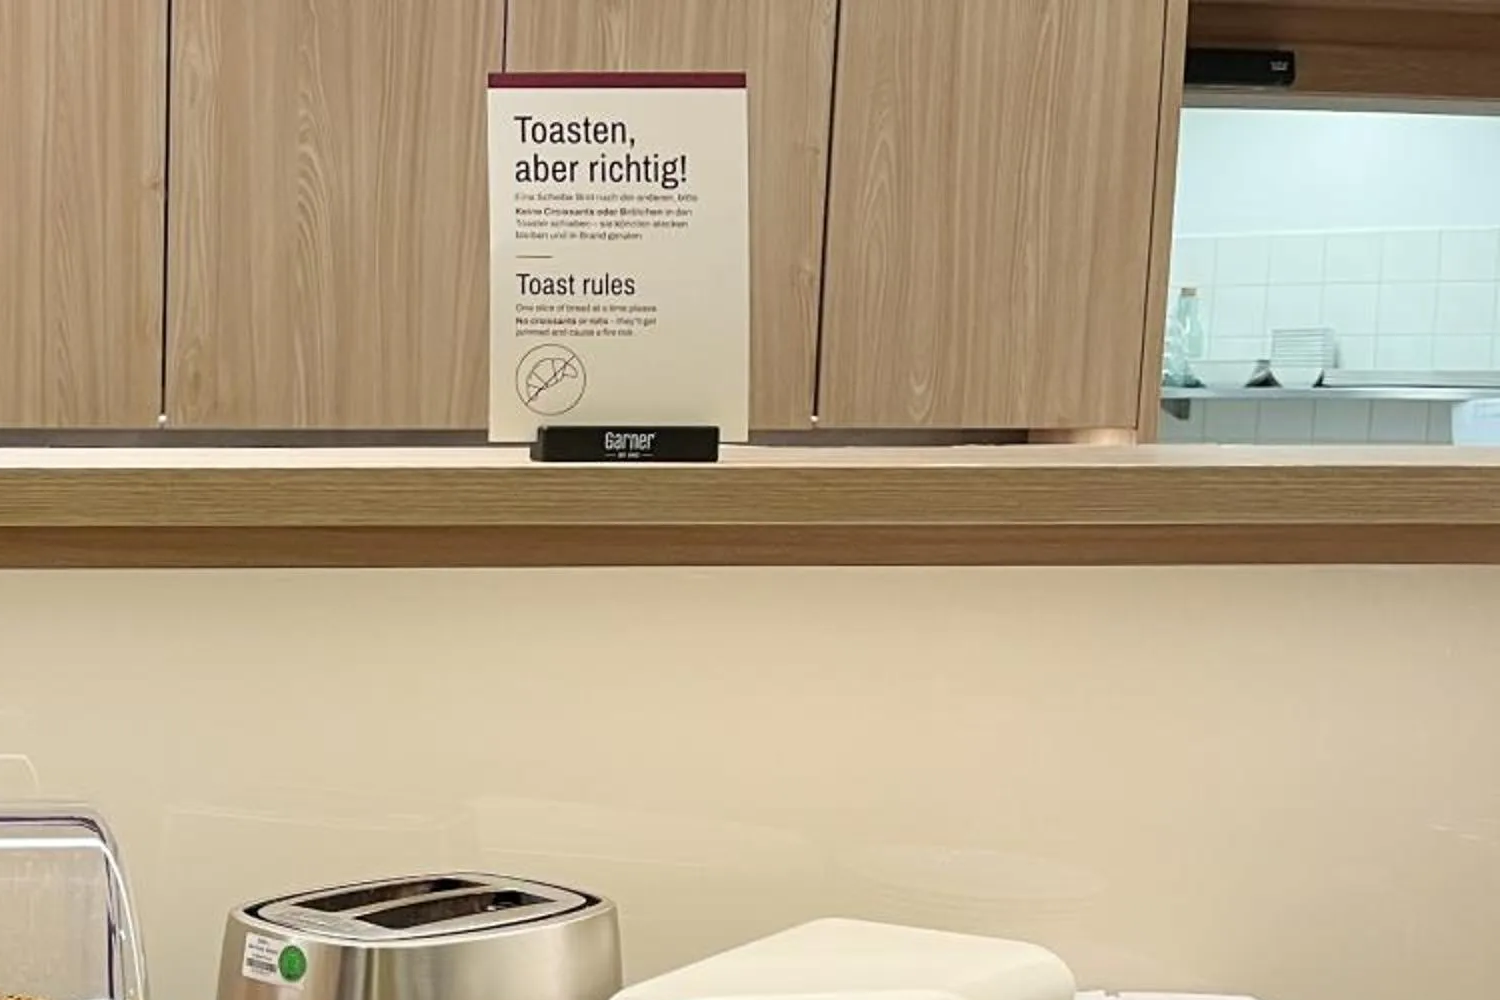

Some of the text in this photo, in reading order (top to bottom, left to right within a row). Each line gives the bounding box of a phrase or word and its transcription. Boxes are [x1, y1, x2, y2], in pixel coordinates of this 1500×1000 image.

[513, 115, 635, 149] Toasten,
[515, 153, 687, 189] aber richtig!
[515, 272, 636, 296] Toast rules
[605, 431, 656, 450] Garner
